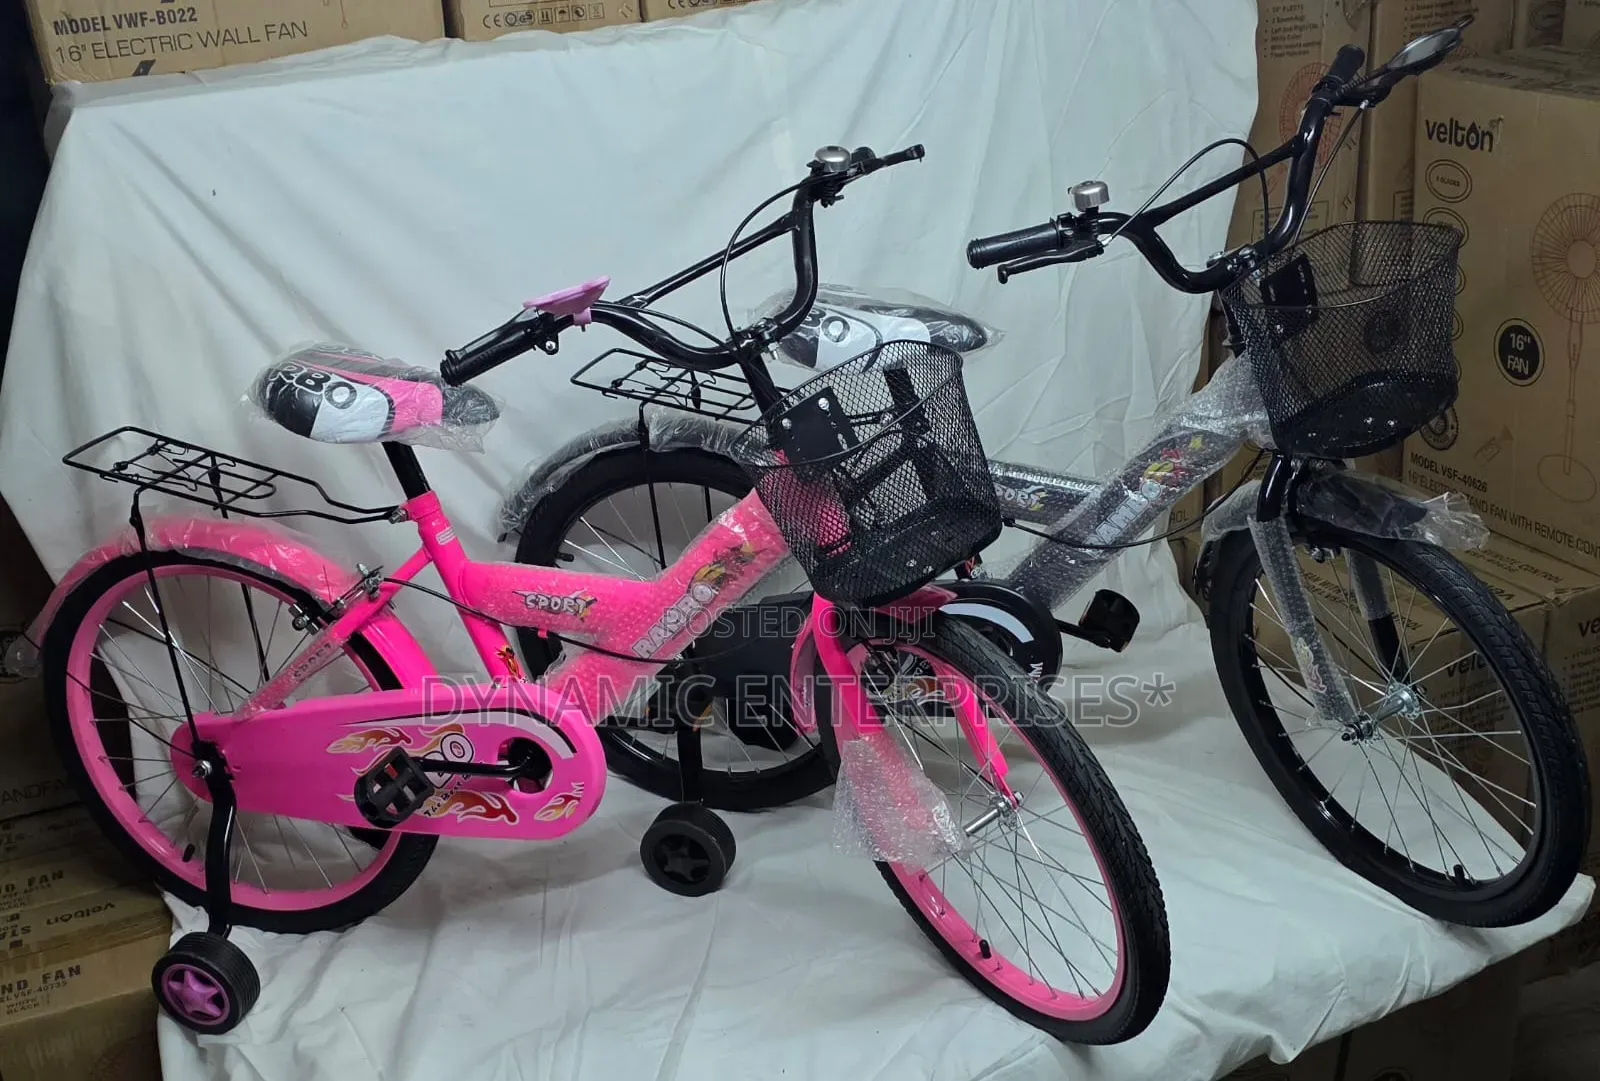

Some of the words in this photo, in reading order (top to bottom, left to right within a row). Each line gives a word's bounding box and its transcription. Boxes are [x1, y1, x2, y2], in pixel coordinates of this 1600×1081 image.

[53, 17, 111, 35] MODEL
[112, 7, 198, 29] VWF-B022
[56, 43, 87, 63] 16"
[93, 33, 194, 59] ELECTRIC
[197, 26, 261, 49] WALL
[265, 21, 309, 41] FAN
[1425, 117, 1494, 152] velton
[1510, 332, 1531, 351] 16"
[1507, 354, 1529, 375] FAN
[1410, 451, 1439, 474] MODEL
[1441, 463, 1488, 492] VSF-40626
[1489, 504, 1508, 521] FAN
[1508, 510, 1532, 532] WITH
[1534, 520, 1574, 548] REMOTE
[525, 593, 588, 615] SPORT
[27, 869, 64, 887] FAN
[46, 902, 116, 926] velton
[42, 965, 81, 984] FAN
